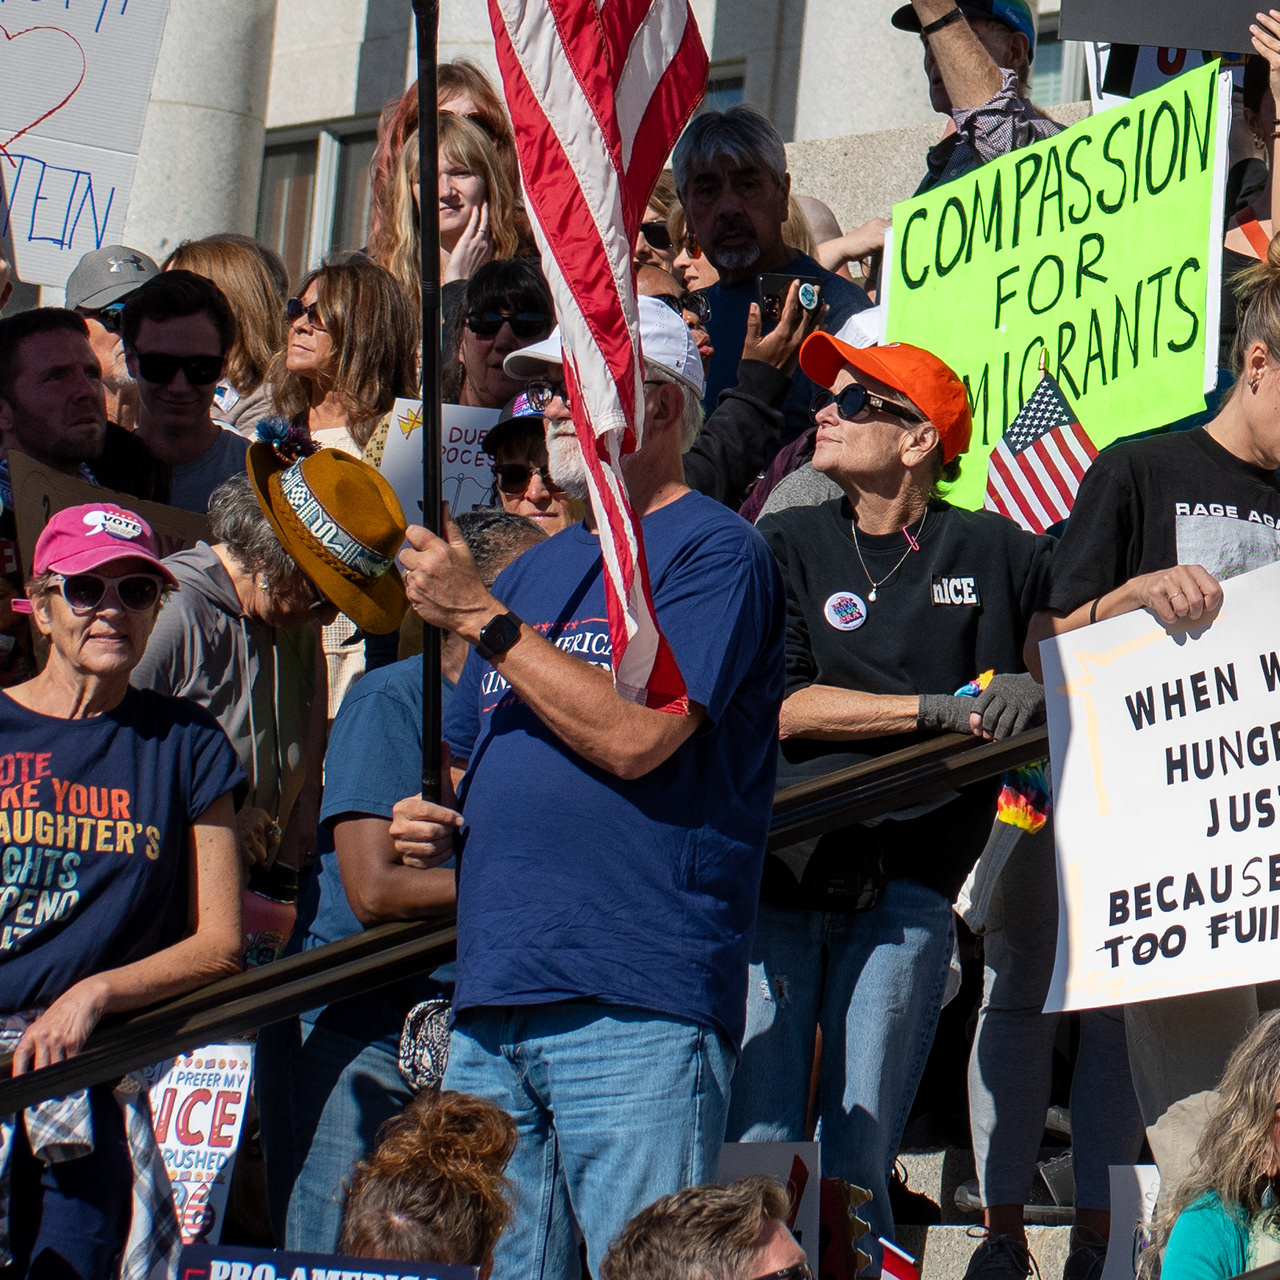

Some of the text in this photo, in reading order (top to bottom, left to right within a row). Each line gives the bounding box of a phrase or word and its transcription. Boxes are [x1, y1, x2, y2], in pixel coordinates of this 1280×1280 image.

[901, 70, 1217, 290] COMPASSION
[995, 232, 1108, 329] FOR
[448, 426, 488, 446] DUE
[102, 514, 142, 533] VOTE
[1175, 502, 1238, 519] RAGE
[932, 576, 979, 607] nICE
[1125, 662, 1238, 731] WHEN
[52, 778, 131, 819] YOUR
[1096, 924, 1187, 969] TOO
[168, 1071, 246, 1088] I PREFER MY
[153, 1088, 242, 1148] ICE
